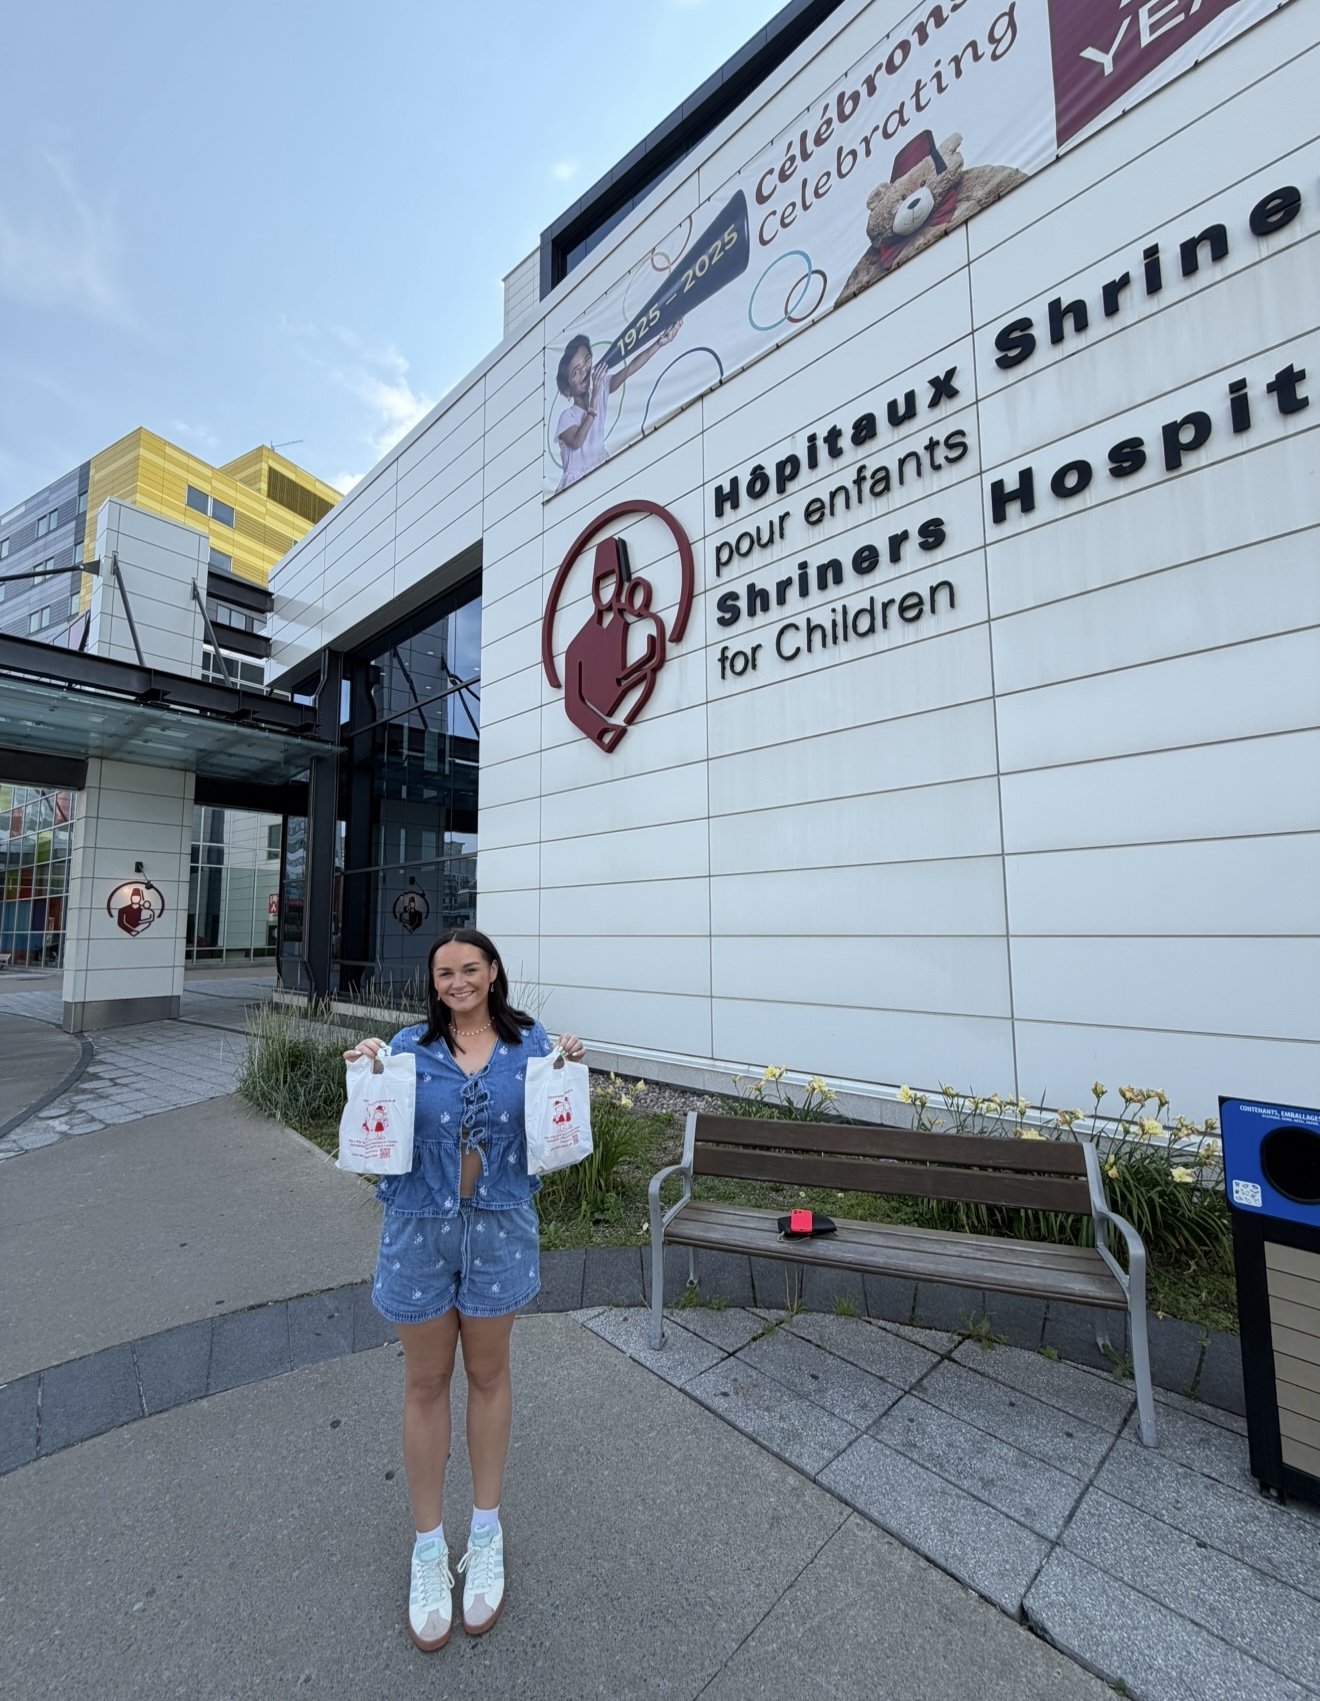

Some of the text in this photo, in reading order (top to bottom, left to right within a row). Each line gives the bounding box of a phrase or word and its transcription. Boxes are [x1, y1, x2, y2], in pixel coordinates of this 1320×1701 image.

[1079, 0, 1201, 77] YE
[758, 1, 1018, 247] Celebrating
[617, 303, 661, 356] 1925
[681, 223, 738, 294] 2025
[714, 180, 1320, 518] Hôpitaux Shrine
[715, 429, 968, 577] pour enfants
[716, 517, 946, 627] Shriners
[717, 580, 956, 680] for Children
[1239, 1104, 1281, 1117] CONTENANTS,
